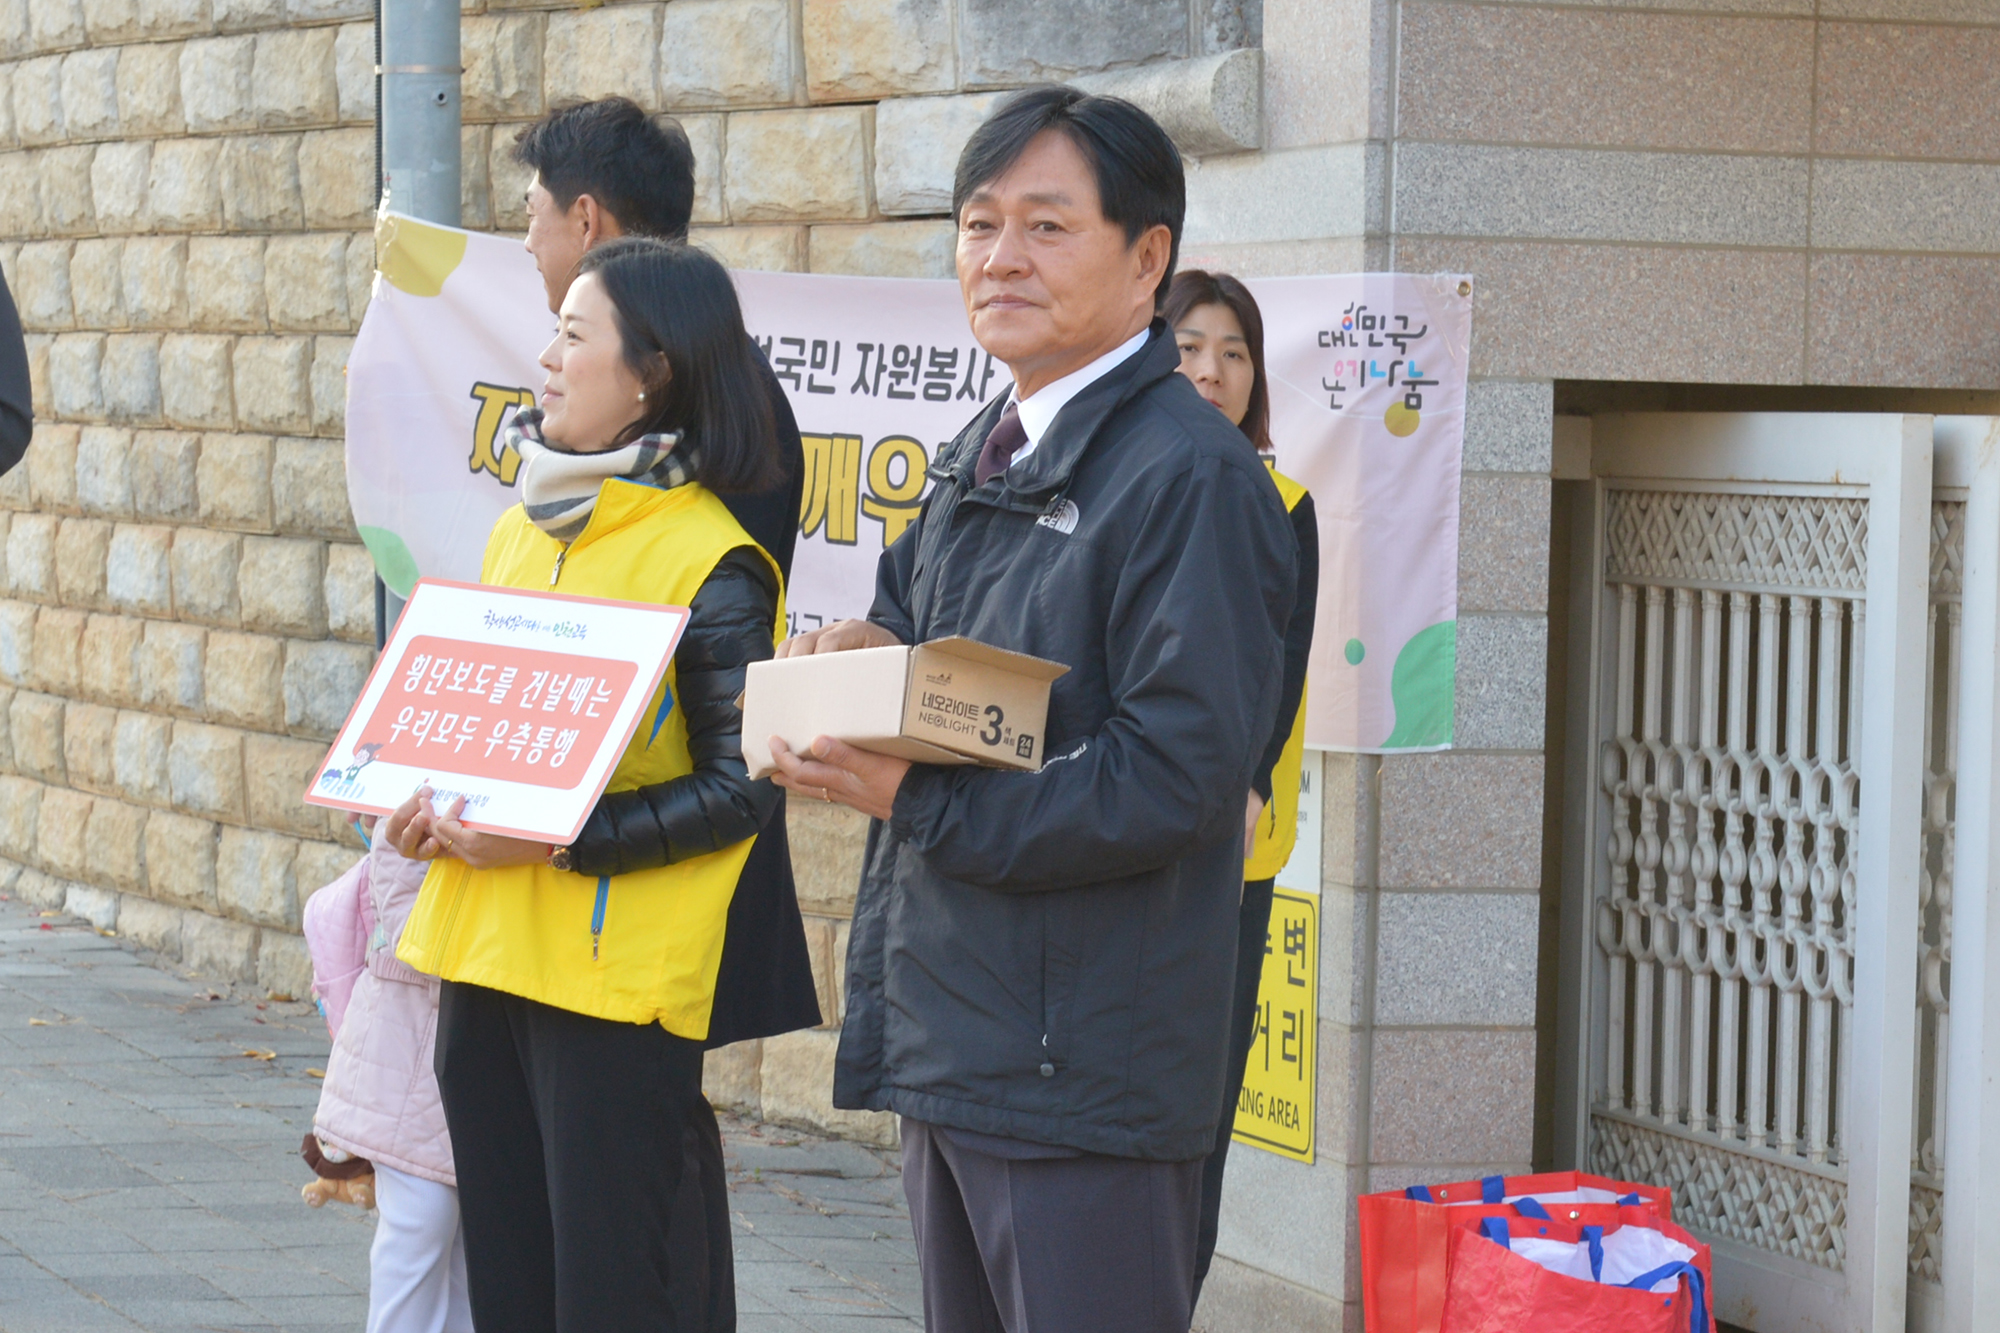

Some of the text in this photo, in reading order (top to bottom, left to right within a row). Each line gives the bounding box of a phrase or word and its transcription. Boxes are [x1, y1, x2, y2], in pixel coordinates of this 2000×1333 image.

[1318, 302, 1428, 355] 대한민국
[1322, 359, 1440, 410] 온기나눔
[403, 653, 613, 719] 횡단보도를 건널때는
[921, 691, 980, 721] 네오라이트
[389, 705, 579, 769] 우리모두 우측통행
[918, 710, 977, 736] NEOLIGHT
[980, 704, 1004, 746] 3
[1267, 1096, 1301, 1132] AREA
